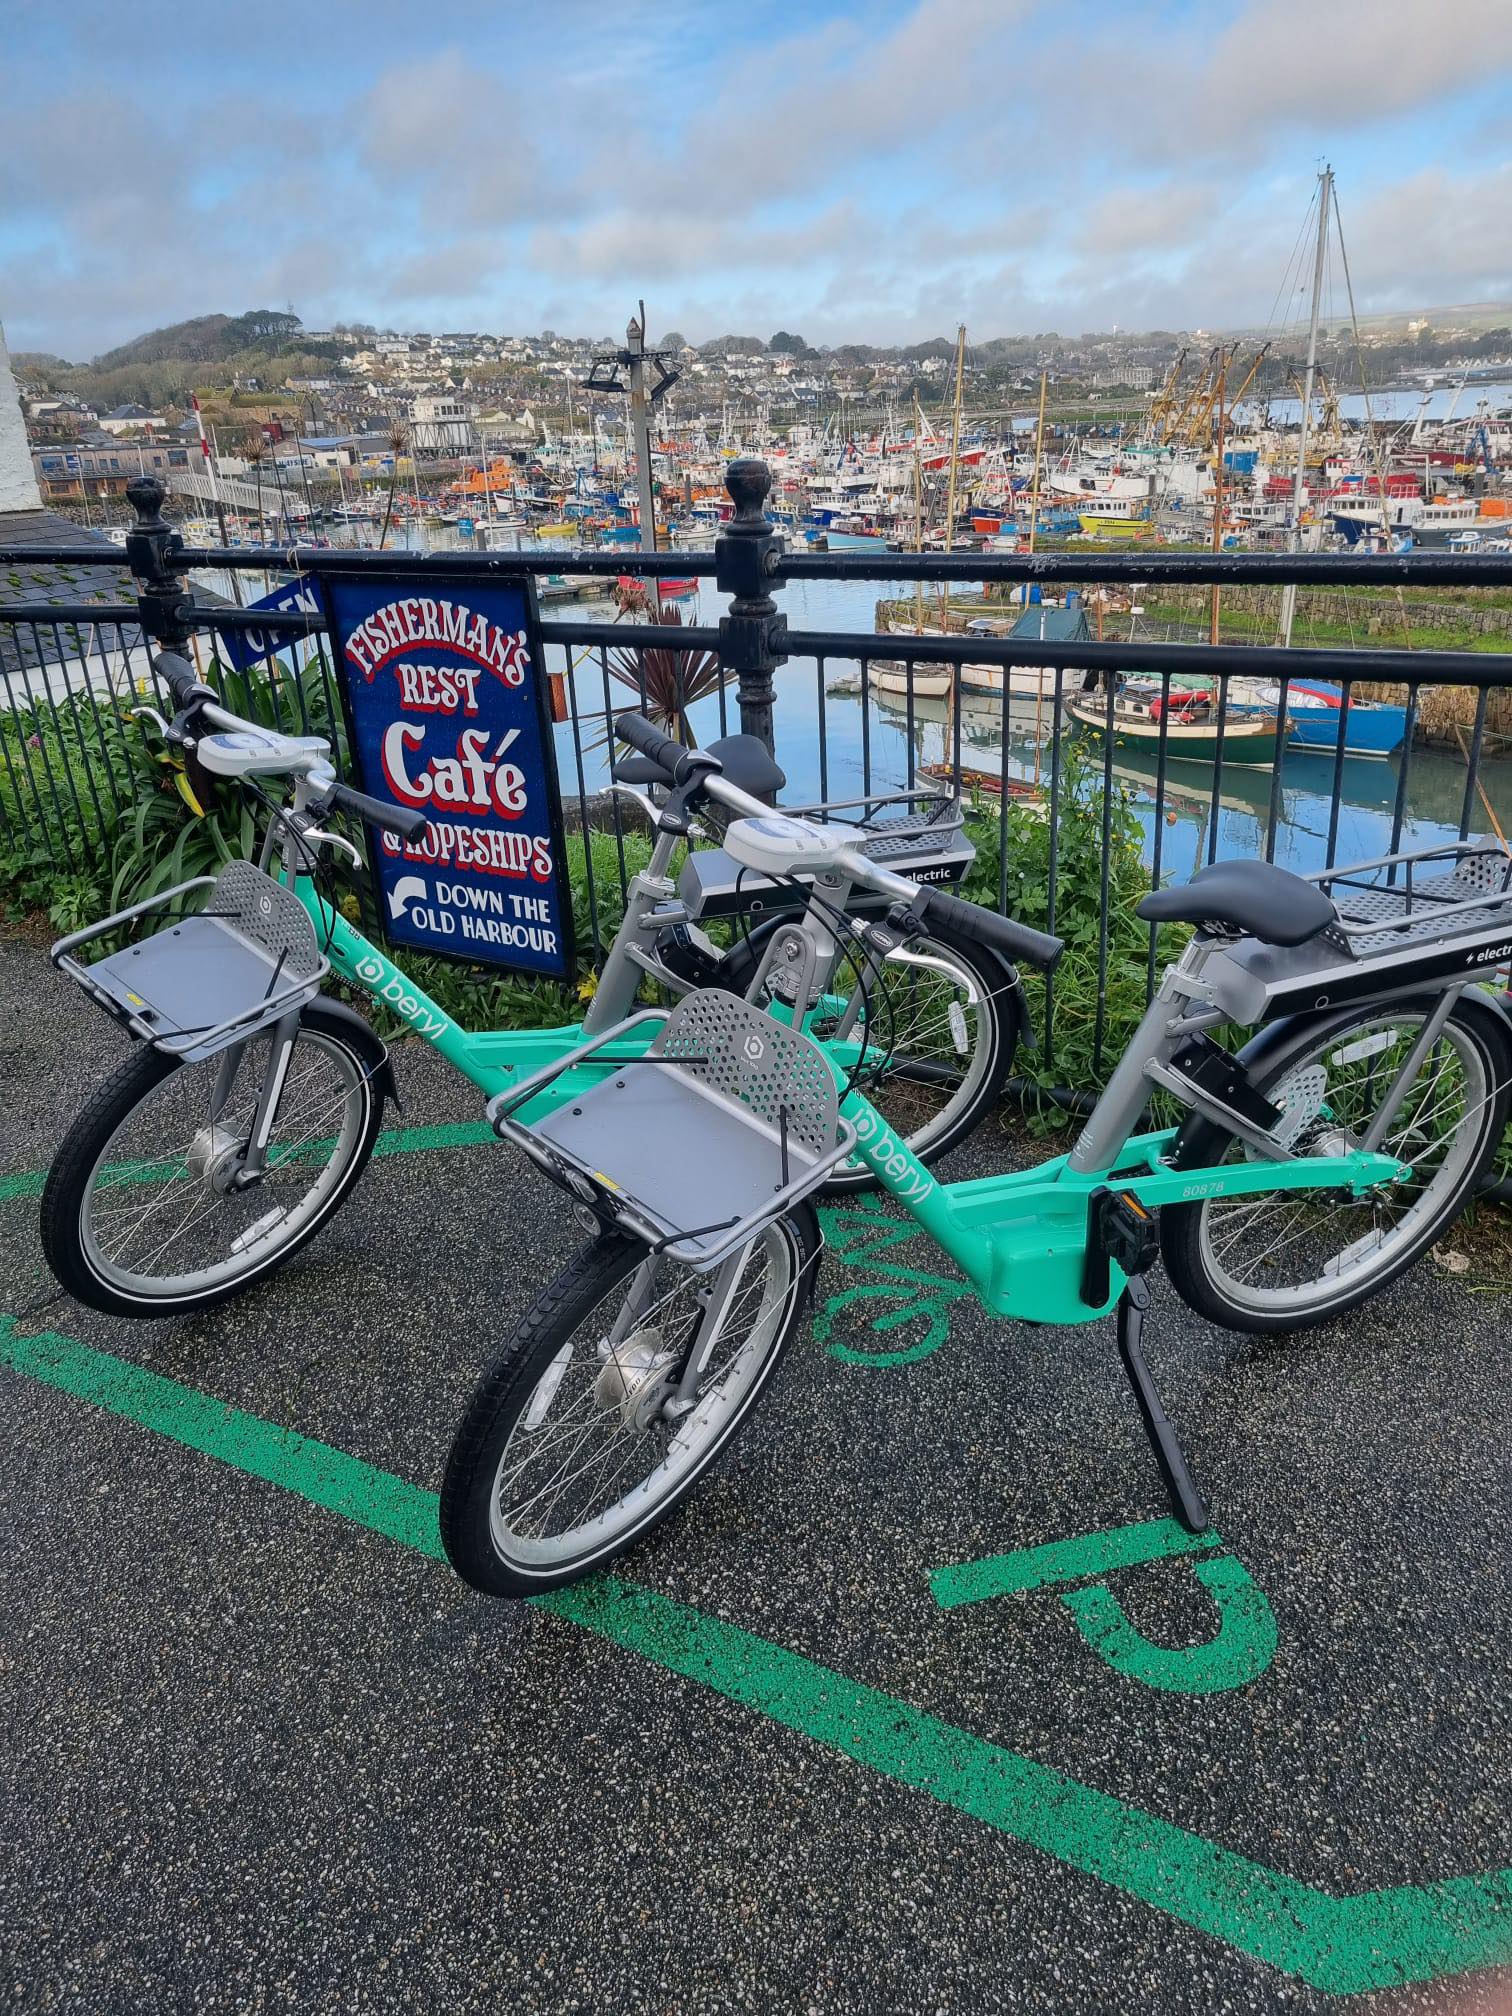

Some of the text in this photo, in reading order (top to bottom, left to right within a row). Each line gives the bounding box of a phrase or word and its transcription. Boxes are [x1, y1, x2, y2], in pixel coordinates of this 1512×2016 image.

[345, 598, 531, 687] FISHERMAN'S
[397, 663, 482, 711] REST
[383, 721, 528, 812] Café
[435, 881, 551, 923] DOWN THE
[905, 868, 951, 883] electric
[411, 906, 557, 955] OLD HARBOUR
[380, 975, 449, 1040] beryl
[869, 1127, 934, 1204] beryl
[1182, 1181, 1225, 1198] 80878
[929, 1516, 1278, 1694] P
